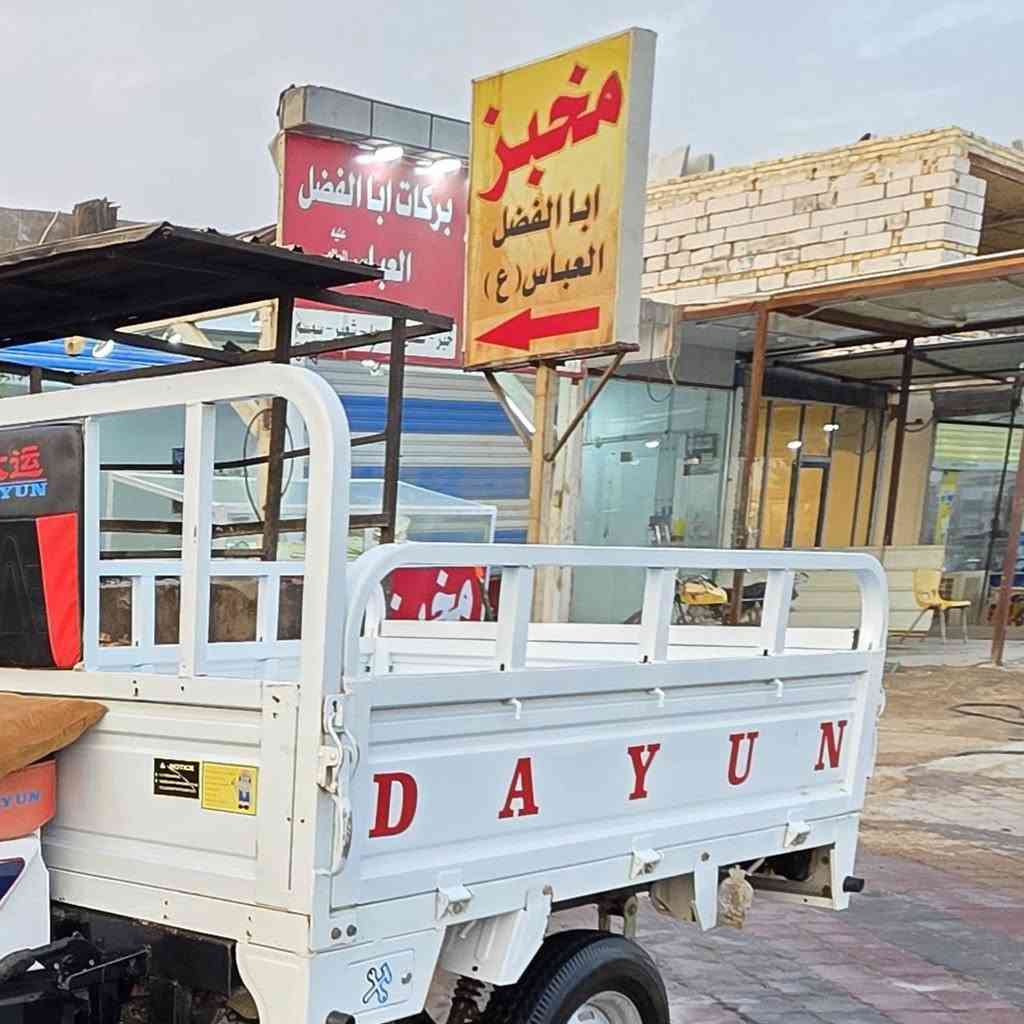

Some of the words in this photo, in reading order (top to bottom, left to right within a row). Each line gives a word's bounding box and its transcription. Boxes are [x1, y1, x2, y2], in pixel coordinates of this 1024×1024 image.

[477, 64, 623, 202] مخبز
[297, 164, 363, 210] الفضل
[366, 174, 393, 226] ابا
[394, 178, 453, 237] بركات
[569, 184, 600, 232] ابا
[492, 192, 562, 248] الفضل
